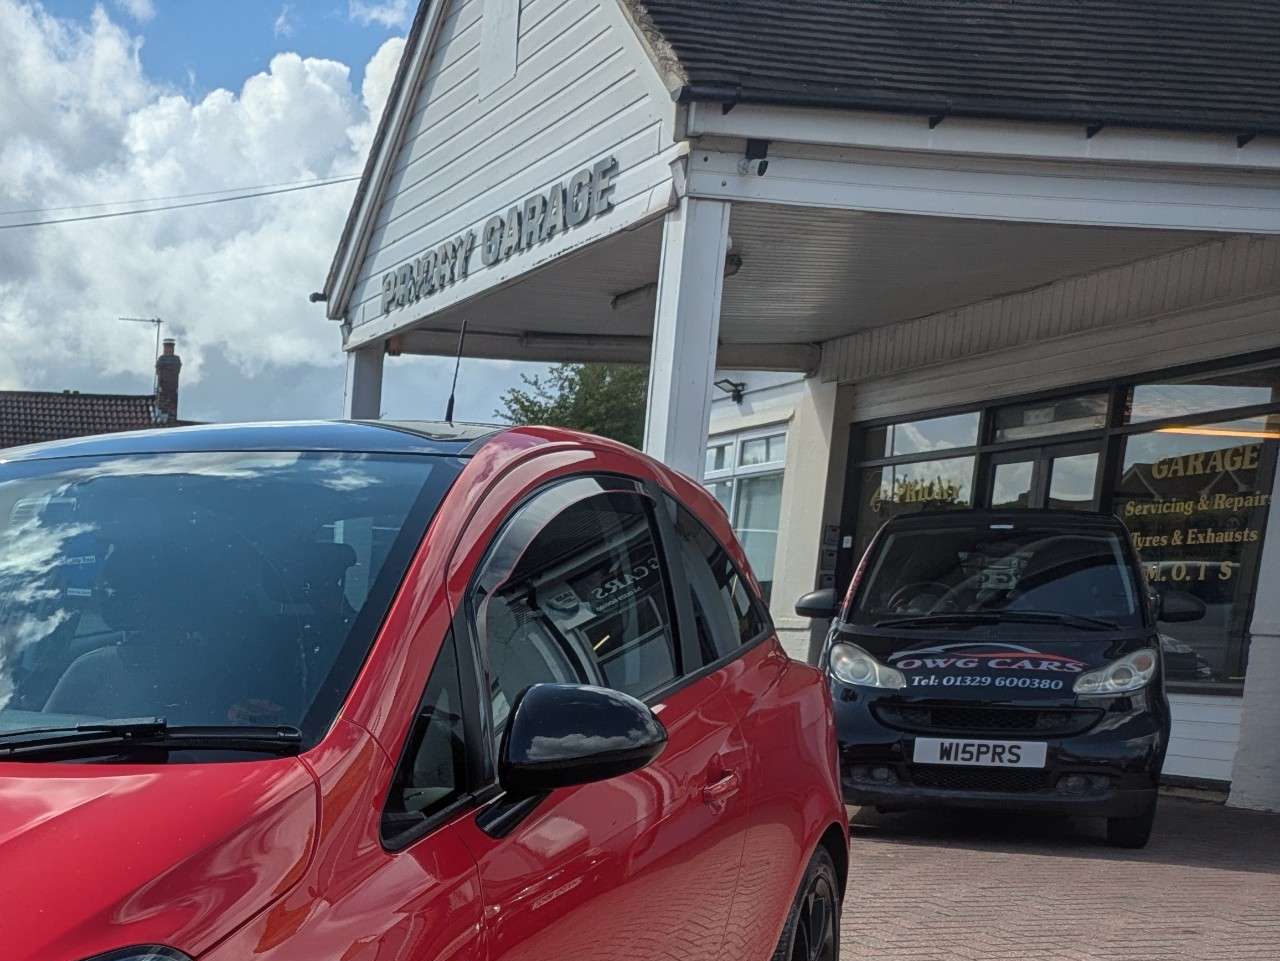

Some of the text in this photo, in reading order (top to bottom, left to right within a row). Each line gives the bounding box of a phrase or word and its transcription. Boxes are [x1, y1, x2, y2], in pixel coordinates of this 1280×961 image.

[381, 154, 619, 315] PRIORY GARAGE
[1151, 445, 1260, 480] GARAGE
[1125, 497, 1194, 516] Servicing
[1198, 494, 1210, 511] &
[1130, 528, 1258, 550] Tyres & Exhausts
[896, 658, 1084, 673] OWG CARS
[911, 675, 1064, 690] Tel: 01329 600380
[939, 742, 1022, 764] W15PRS
